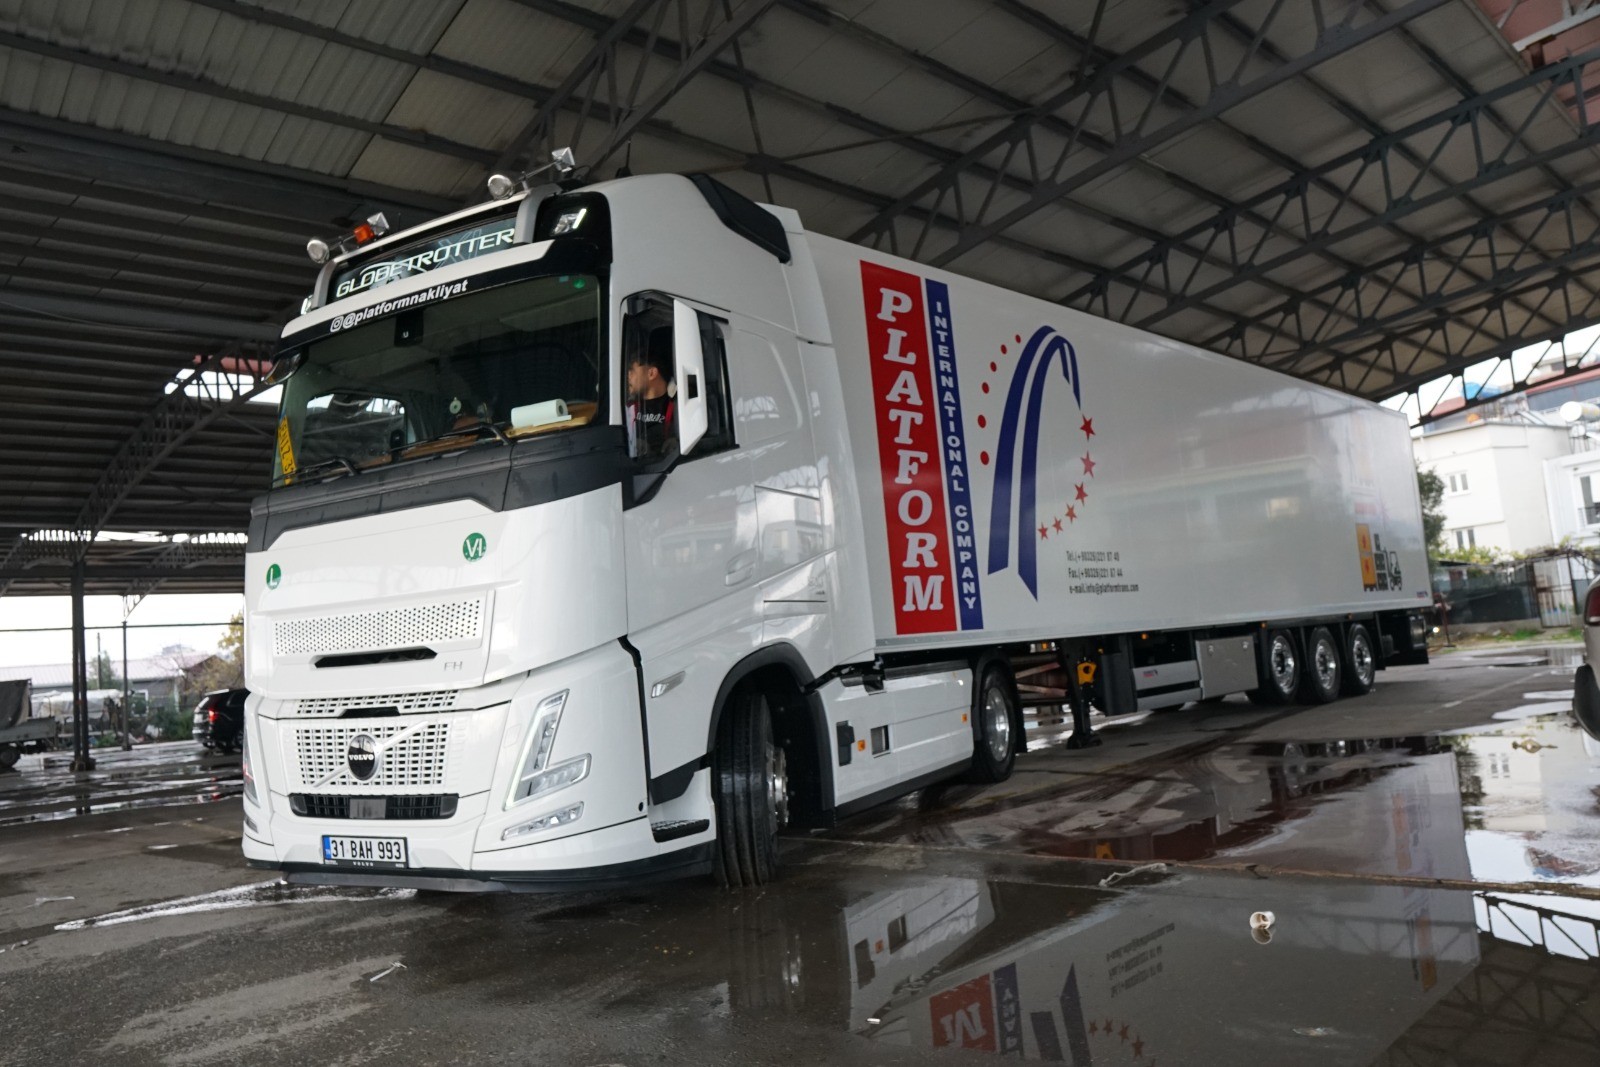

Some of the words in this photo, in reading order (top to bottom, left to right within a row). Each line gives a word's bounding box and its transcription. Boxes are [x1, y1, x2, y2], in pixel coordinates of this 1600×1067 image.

[336, 227, 516, 298] GLOBETROTTER
[343, 279, 469, 330] @platformnakliyat
[876, 287, 945, 613] PLATFORM
[934, 300, 964, 493] INTERNATIONAL
[954, 504, 976, 610] COMPANY
[270, 567, 278, 586] L
[444, 661, 463, 671] FH
[331, 840, 345, 858] 31
[350, 841, 373, 859] BAH
[378, 842, 402, 860] 993
